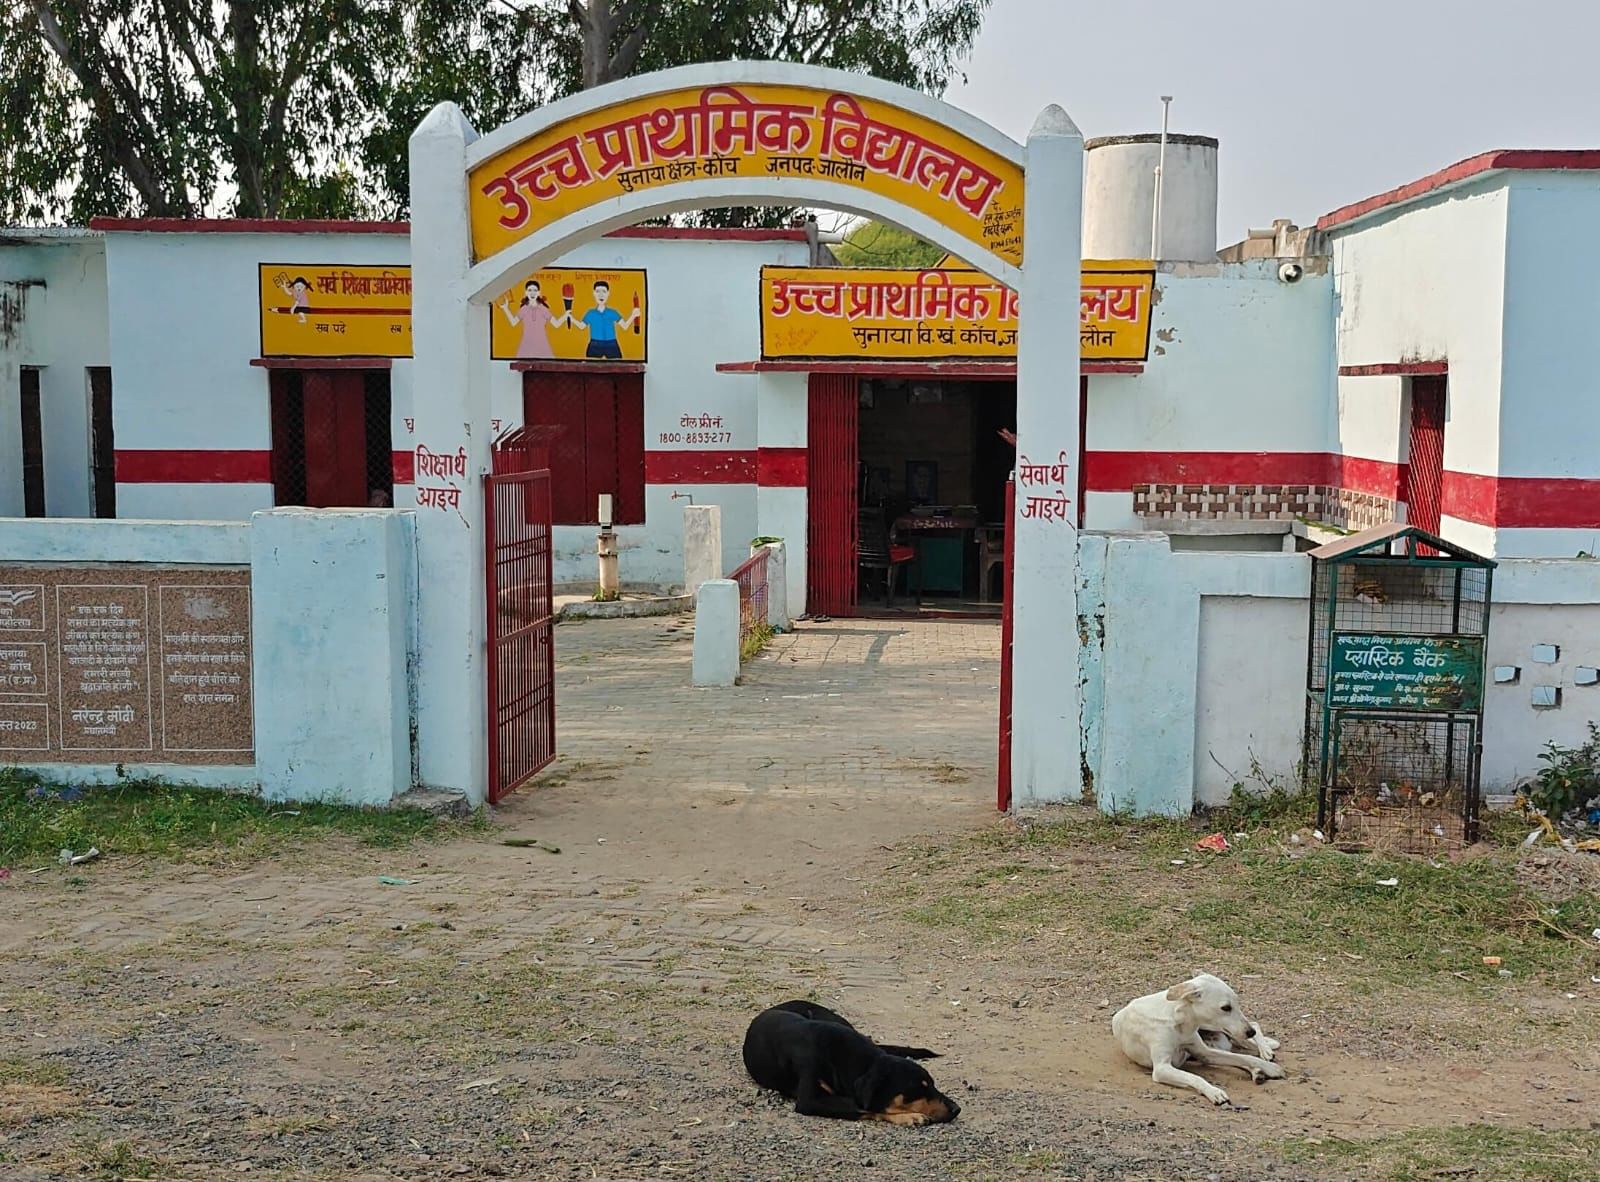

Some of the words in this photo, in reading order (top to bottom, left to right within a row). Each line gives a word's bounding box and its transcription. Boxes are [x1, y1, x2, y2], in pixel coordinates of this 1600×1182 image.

[481, 135, 593, 231] उच्च
[584, 86, 816, 180] प्राथमिक
[820, 93, 1006, 219] विद्यालय
[616, 166, 666, 193] सुनाया
[316, 271, 339, 294] सर्व
[341, 271, 371, 299] शिक्षा
[372, 271, 412, 296] अभिया
[770, 279, 847, 318] उच्च
[847, 269, 996, 322] प्राथमिक
[315, 323, 329, 334] सब
[390, 324, 402, 334] सब
[852, 326, 912, 349] सुनाया
[680, 413, 697, 429] टोल
[698, 412, 712, 429] फ्री
[416, 443, 467, 481] शिक्षार्थ
[1020, 451, 1069, 488] सेवार्थ
[416, 482, 462, 512] आइये
[1020, 490, 1071, 523] जाइये
[1345, 646, 1405, 669] प्लास्टिक
[1412, 647, 1449, 667] बैंक
[107, 704, 135, 723] मोदी
